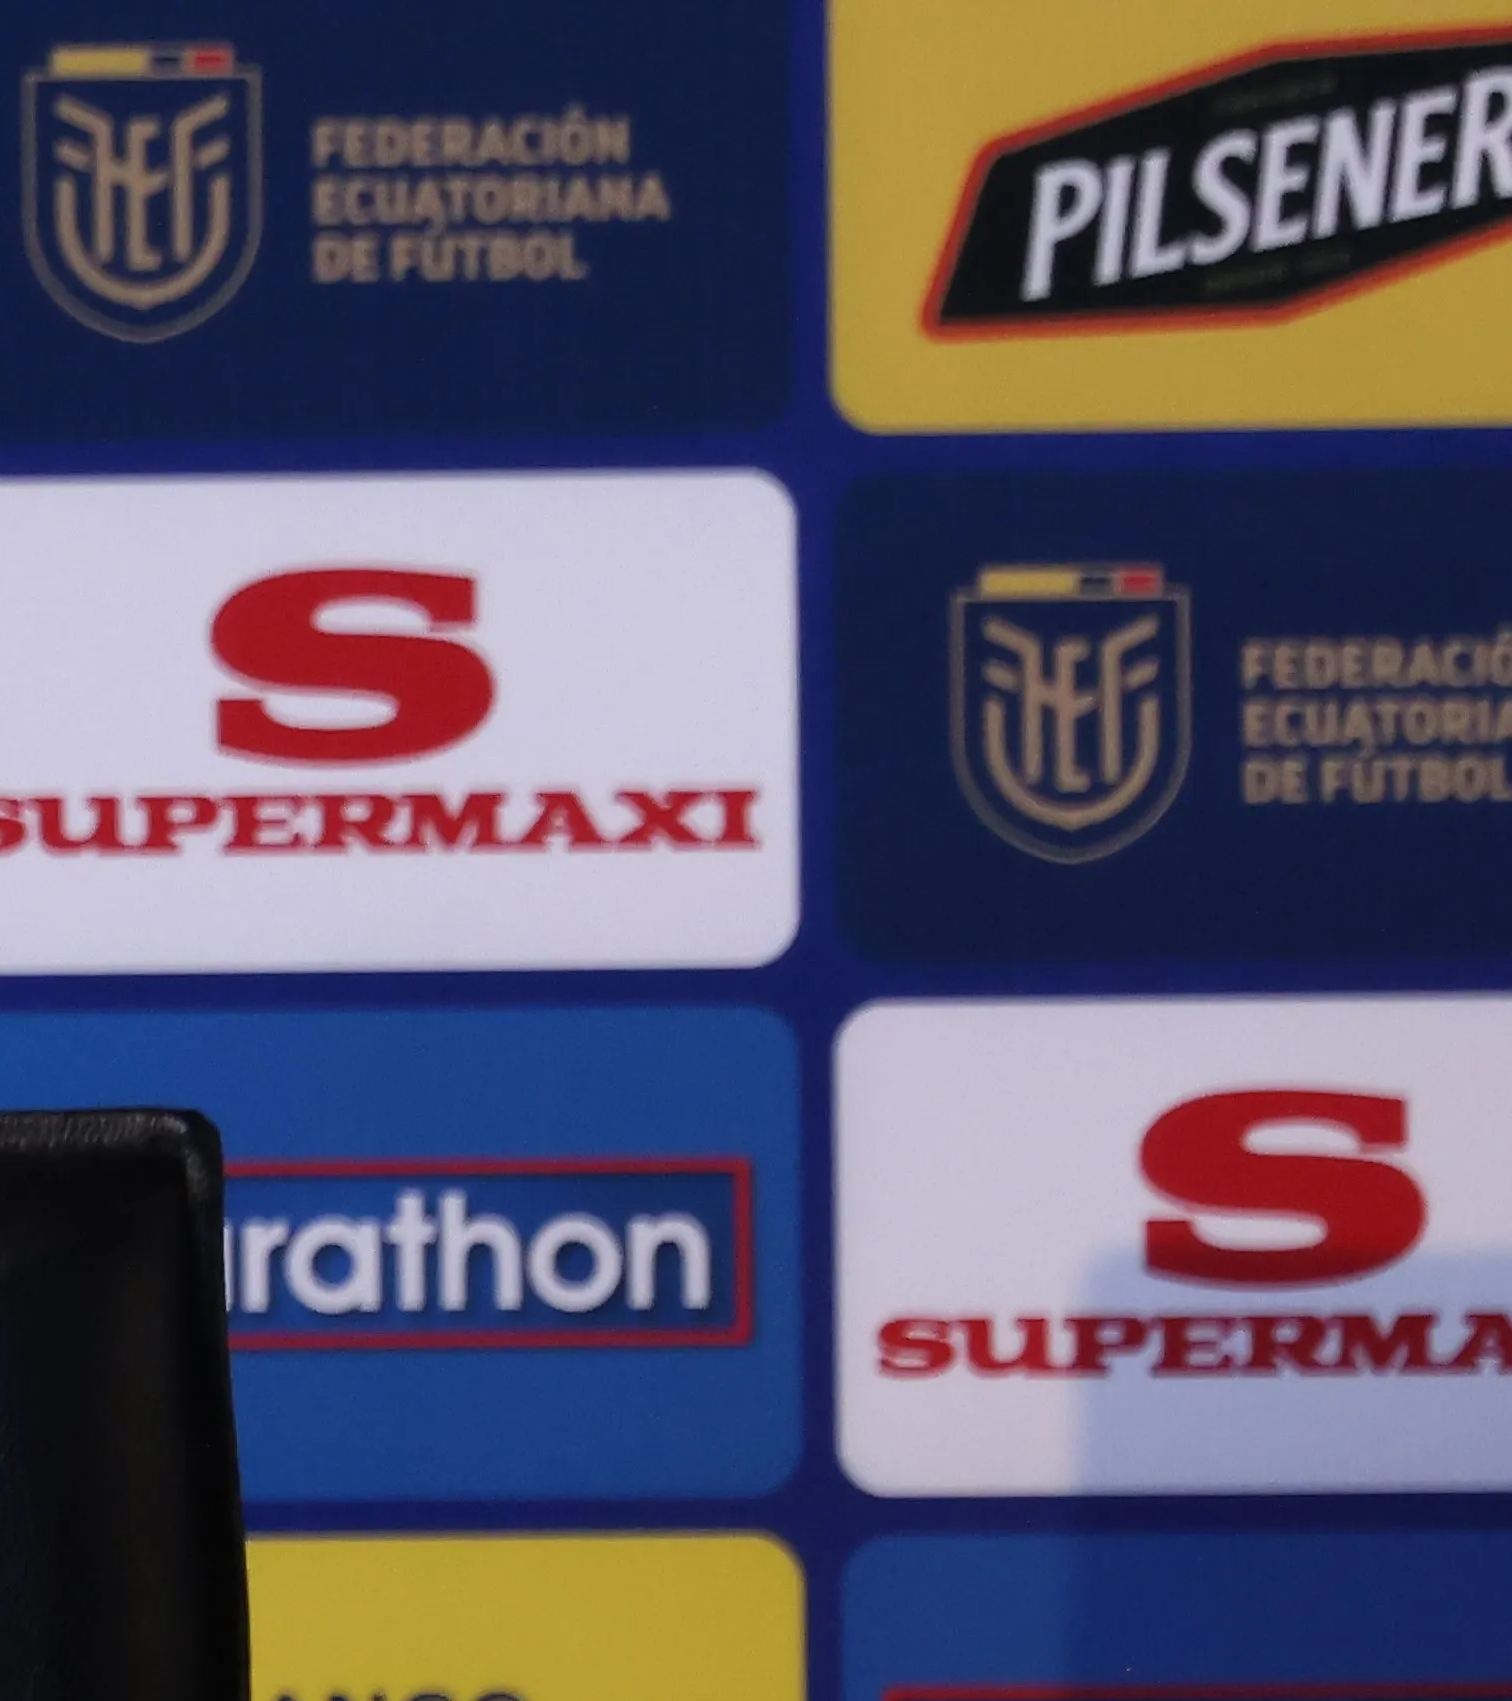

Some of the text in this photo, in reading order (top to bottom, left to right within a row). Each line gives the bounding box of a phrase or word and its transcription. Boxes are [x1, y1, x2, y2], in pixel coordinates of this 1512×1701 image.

[312, 104, 631, 167] FEDERACIÓN
[312, 173, 672, 223] ECUATORIANA
[1021, 64, 1512, 301] PILSENER
[313, 218, 587, 283] DE FÚTBOL
[211, 562, 495, 769] S
[1240, 626, 1512, 690] FEDERACIÓ
[1240, 700, 1512, 747] ECUATORIA
[1241, 757, 1310, 803] DE
[1137, 1085, 1428, 1293] S
[223, 1188, 711, 1315] rathon
[876, 1310, 1512, 1378] SUPERMA
